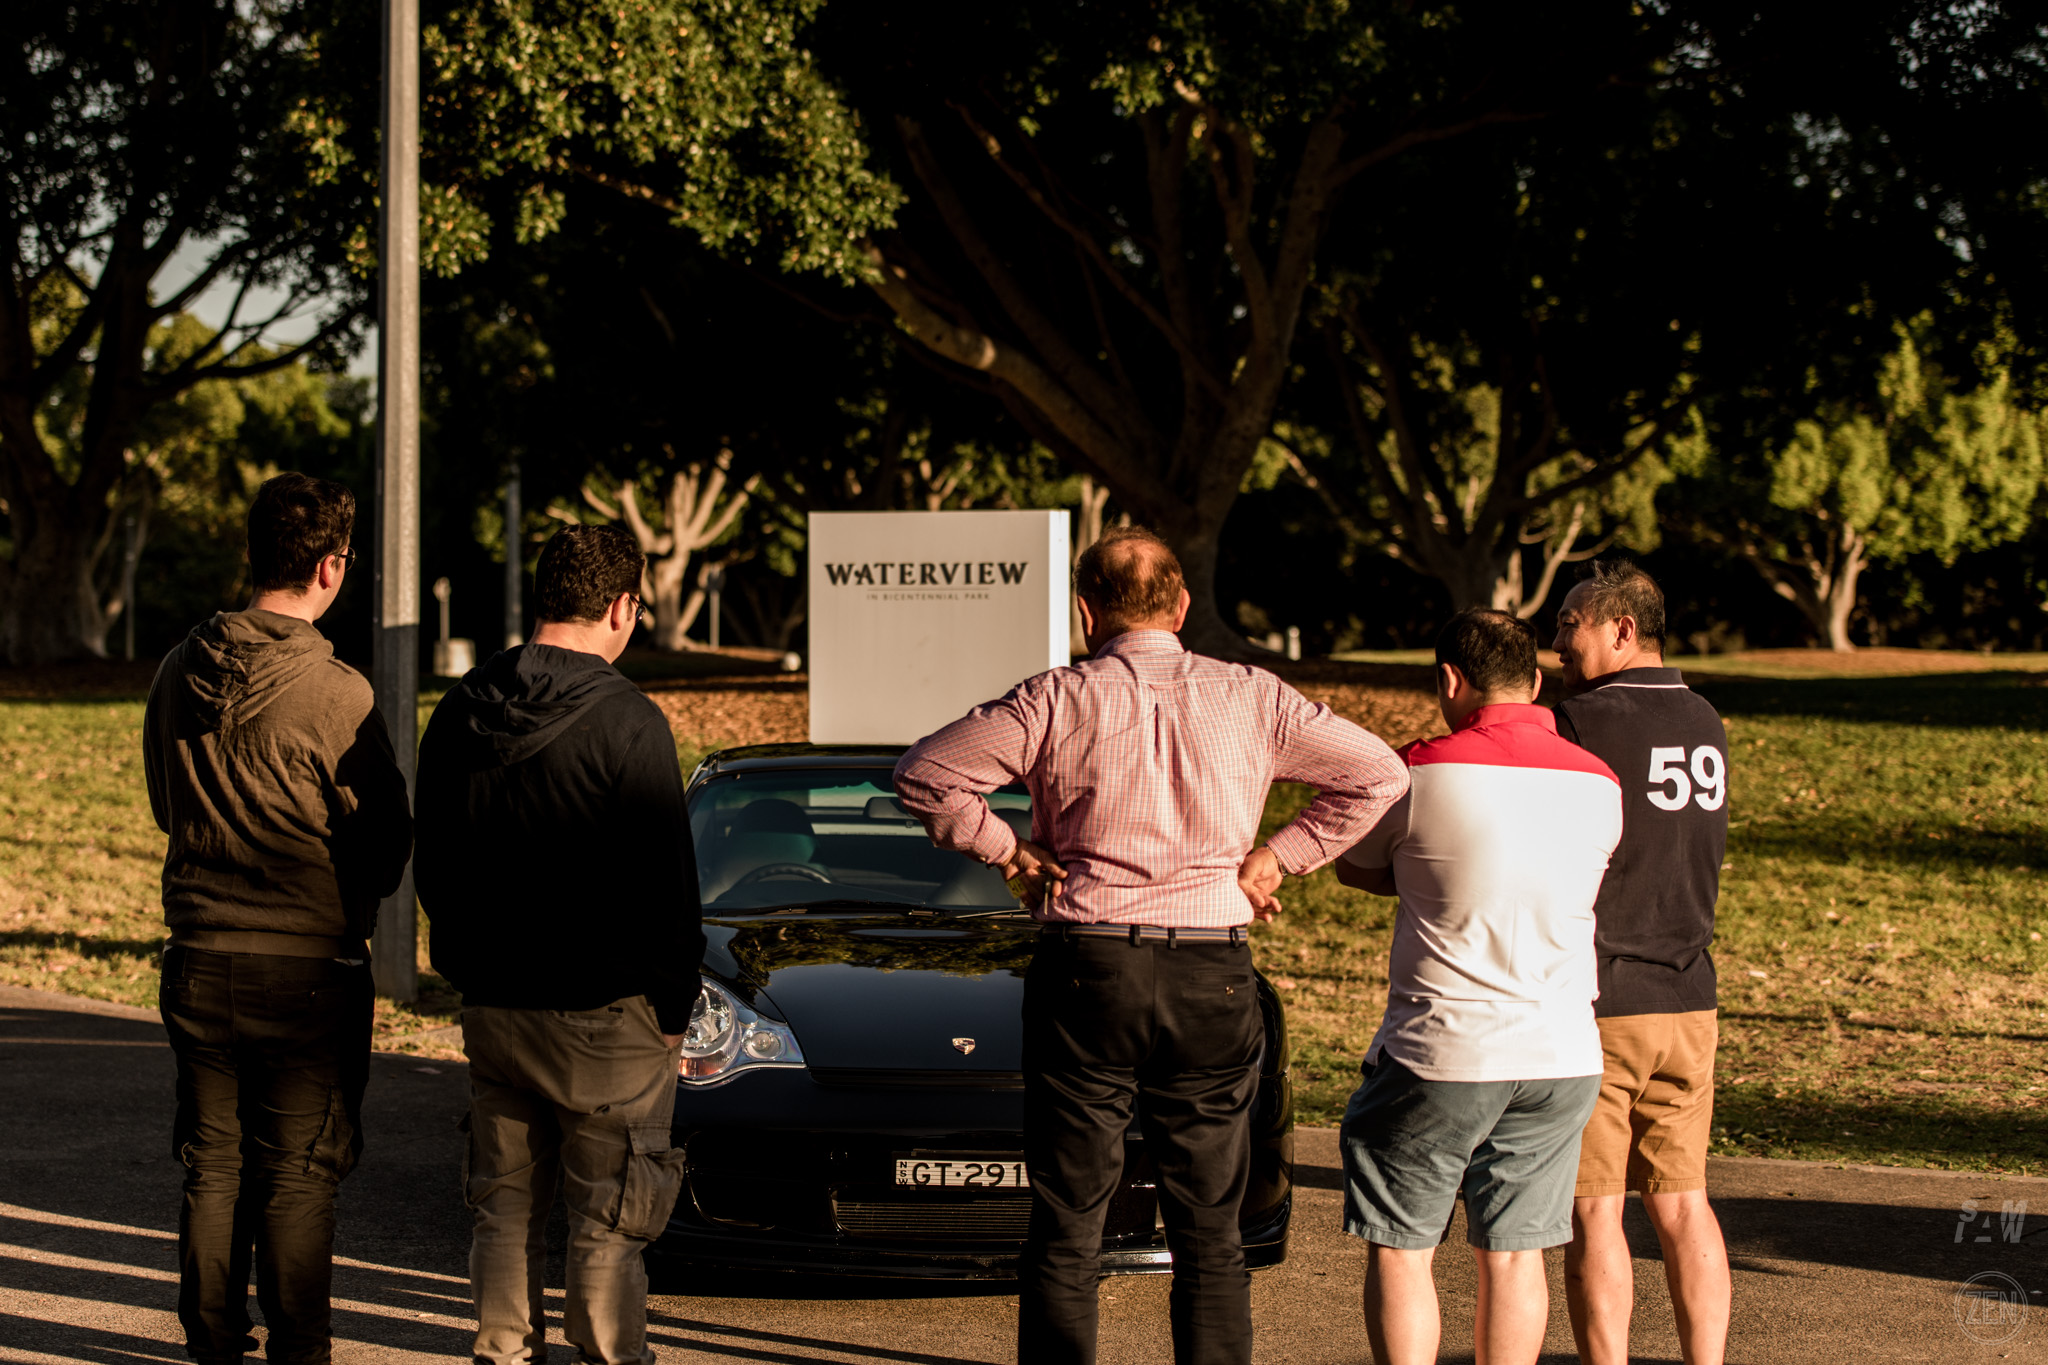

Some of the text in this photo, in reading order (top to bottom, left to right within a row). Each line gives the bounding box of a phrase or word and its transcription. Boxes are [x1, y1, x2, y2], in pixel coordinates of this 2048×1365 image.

[824, 562, 1029, 586] WATERVIEW
[866, 592, 989, 600] IN BICENTENNIAL PARK
[1646, 745, 1726, 811] 59
